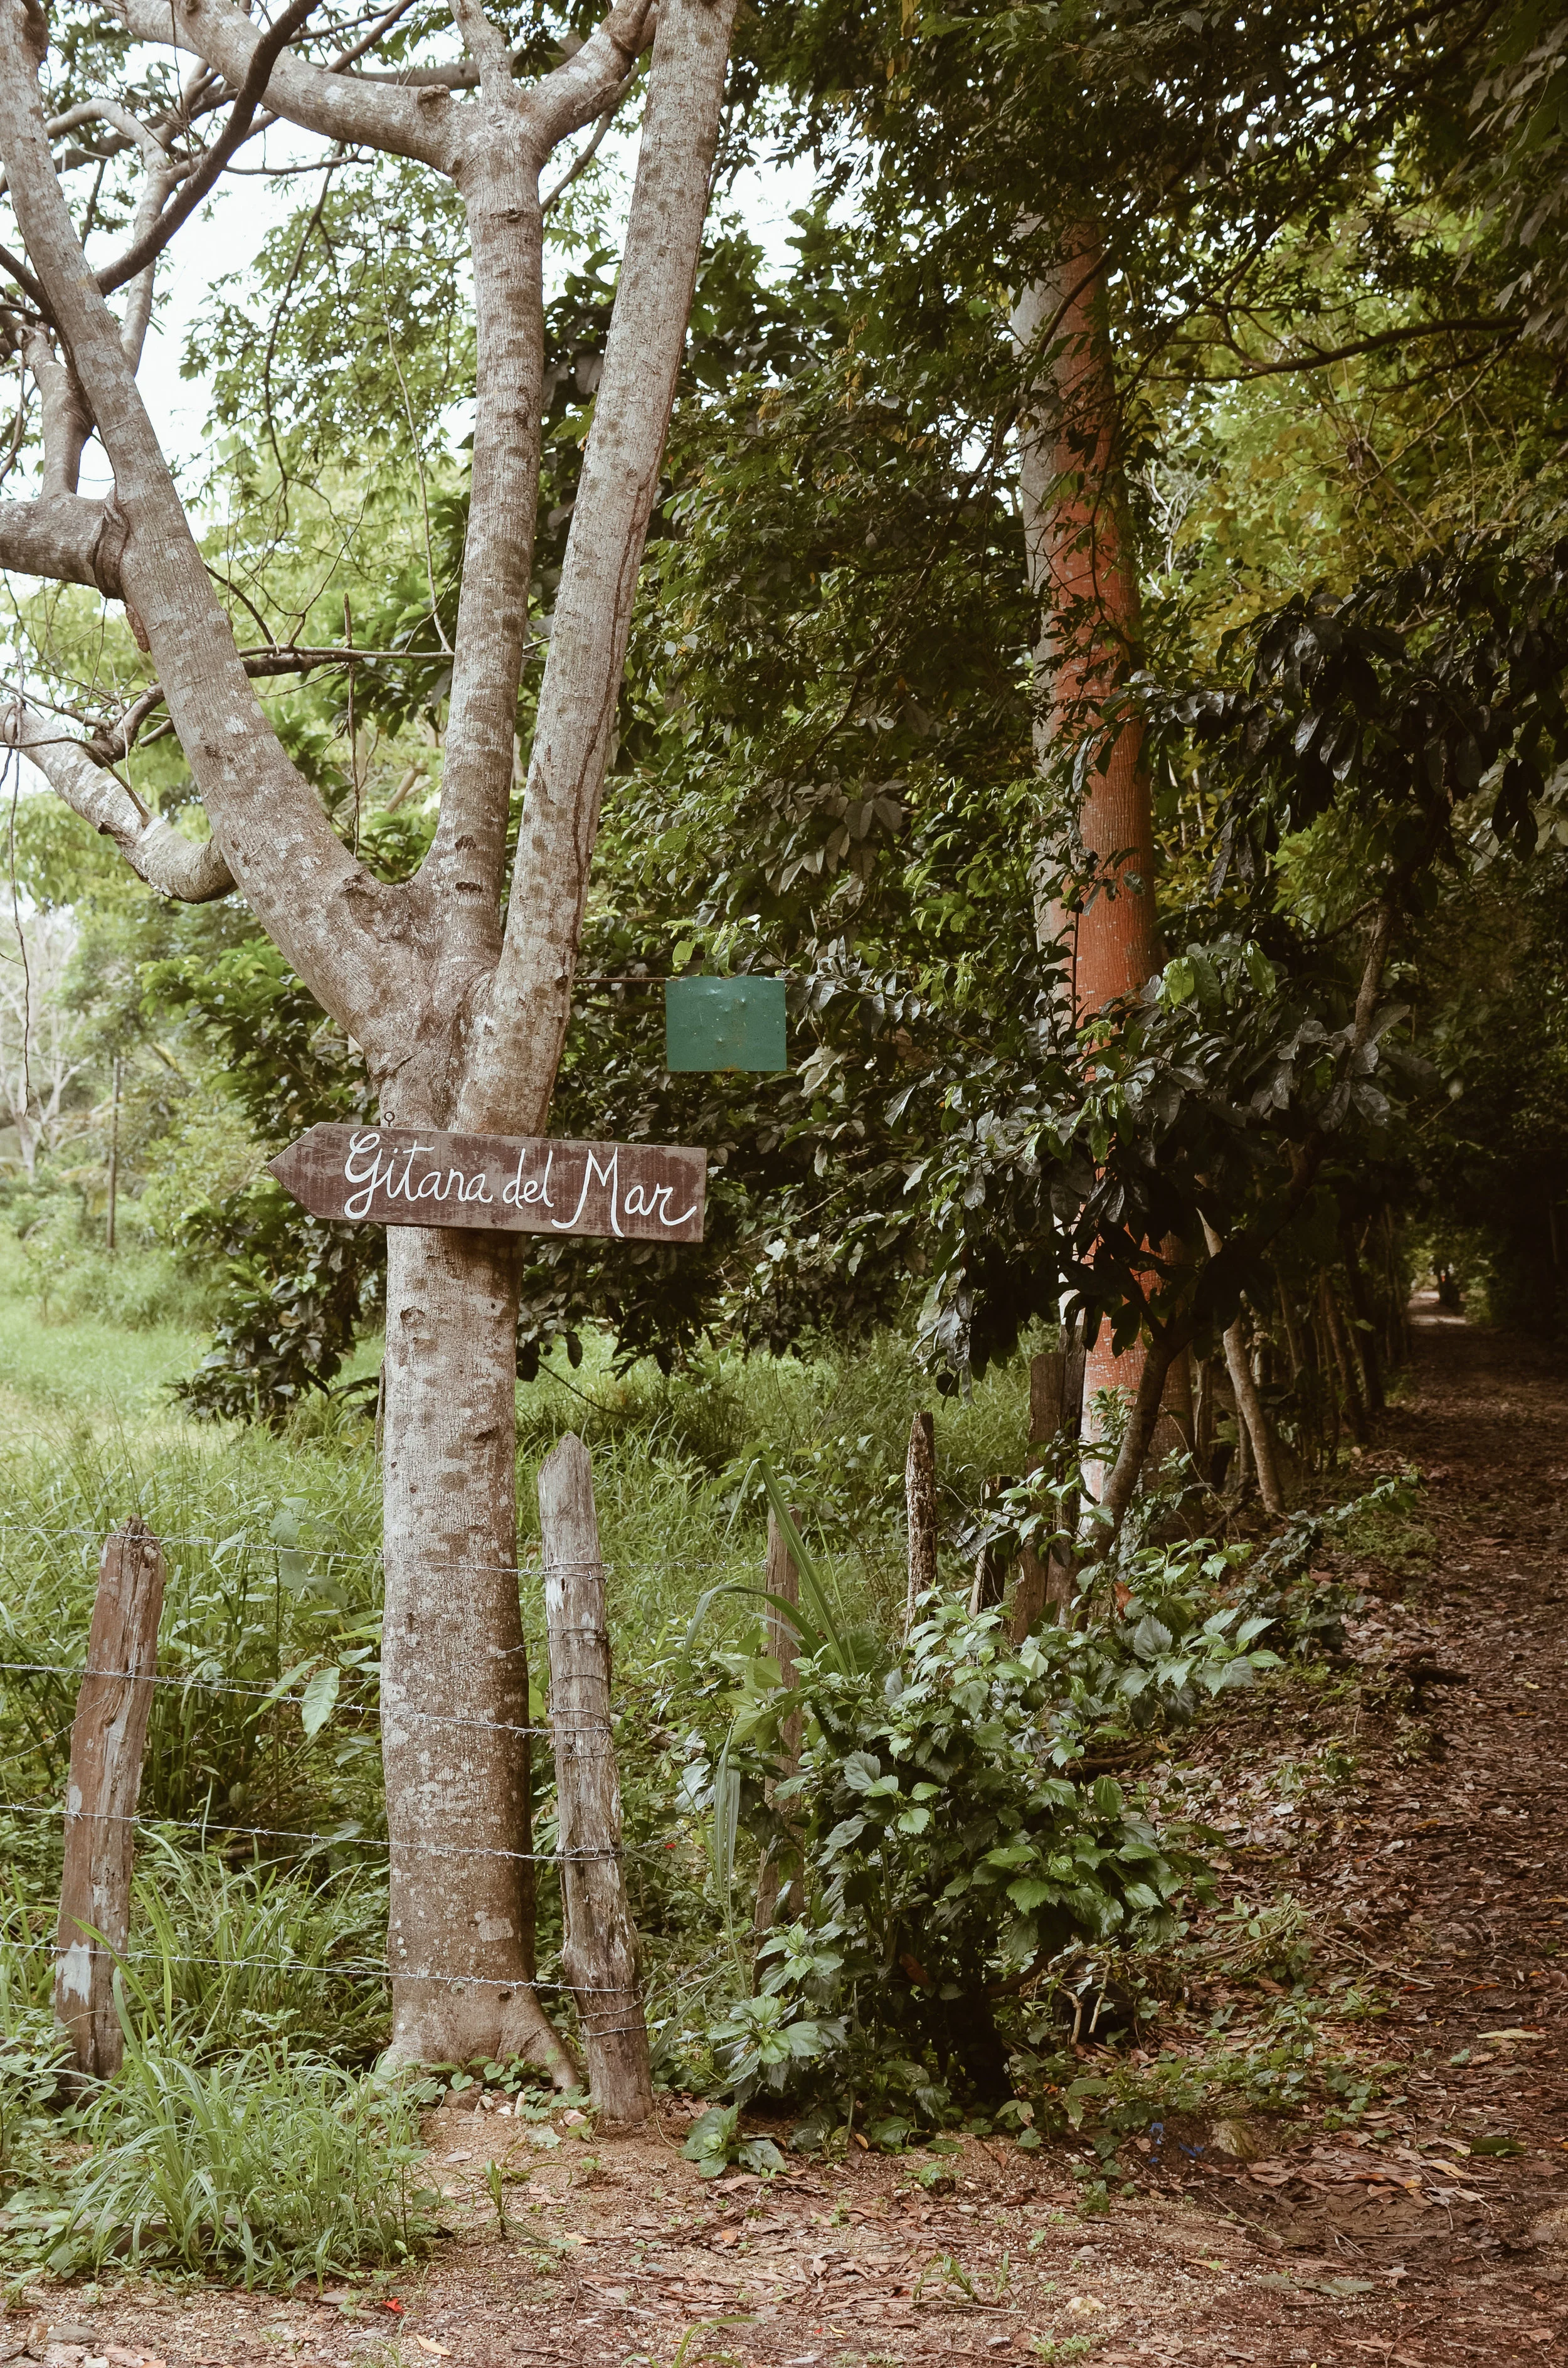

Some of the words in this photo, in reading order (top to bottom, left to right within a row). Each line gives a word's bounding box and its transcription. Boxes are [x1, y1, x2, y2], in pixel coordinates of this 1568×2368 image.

[344, 1130, 493, 1219] Gitana
[502, 1148, 554, 1209] del
[551, 1146, 697, 1238] Mar
